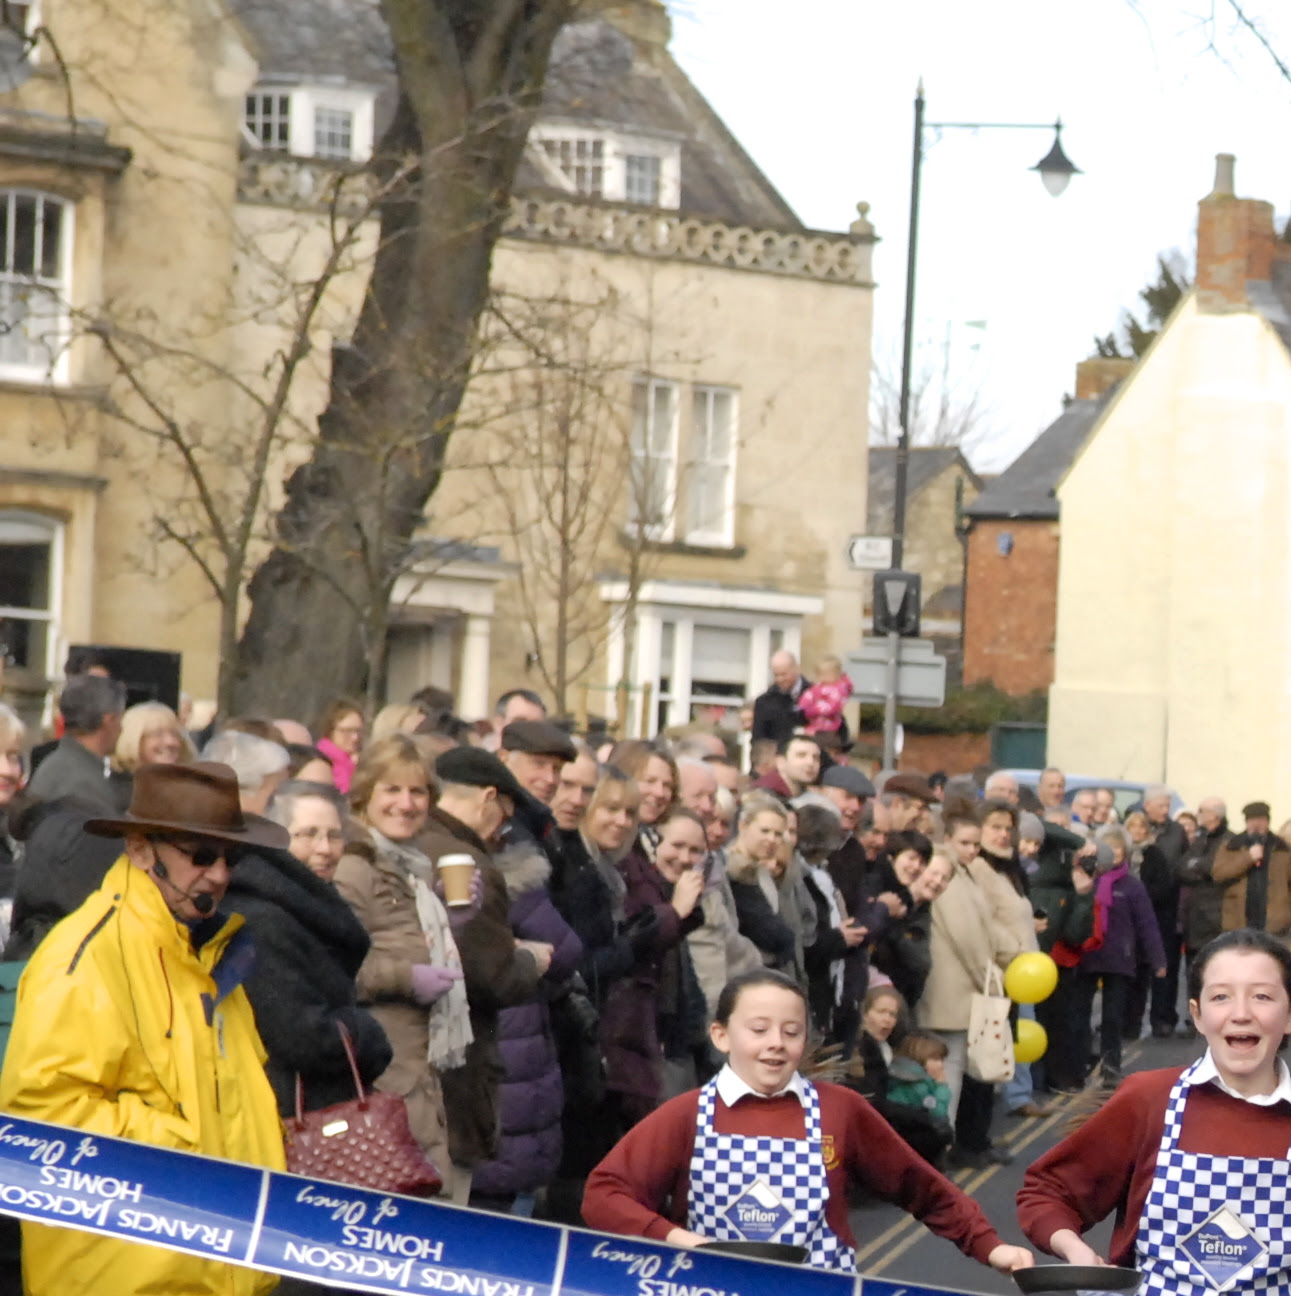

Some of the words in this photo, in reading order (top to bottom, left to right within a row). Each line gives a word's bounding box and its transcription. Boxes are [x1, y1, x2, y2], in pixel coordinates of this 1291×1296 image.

[71, 1136, 98, 1165] of
[40, 1165, 143, 1202] HOMES
[0, 1183, 113, 1226] JACKSO
[295, 1185, 366, 1224] Olney
[371, 1197, 398, 1224] of
[117, 1208, 233, 1252] FRANCIS
[342, 1225, 443, 1261] HOMES
[283, 1241, 416, 1287] JACKSON
[591, 1241, 661, 1278] Olney
[666, 1251, 693, 1278] of
